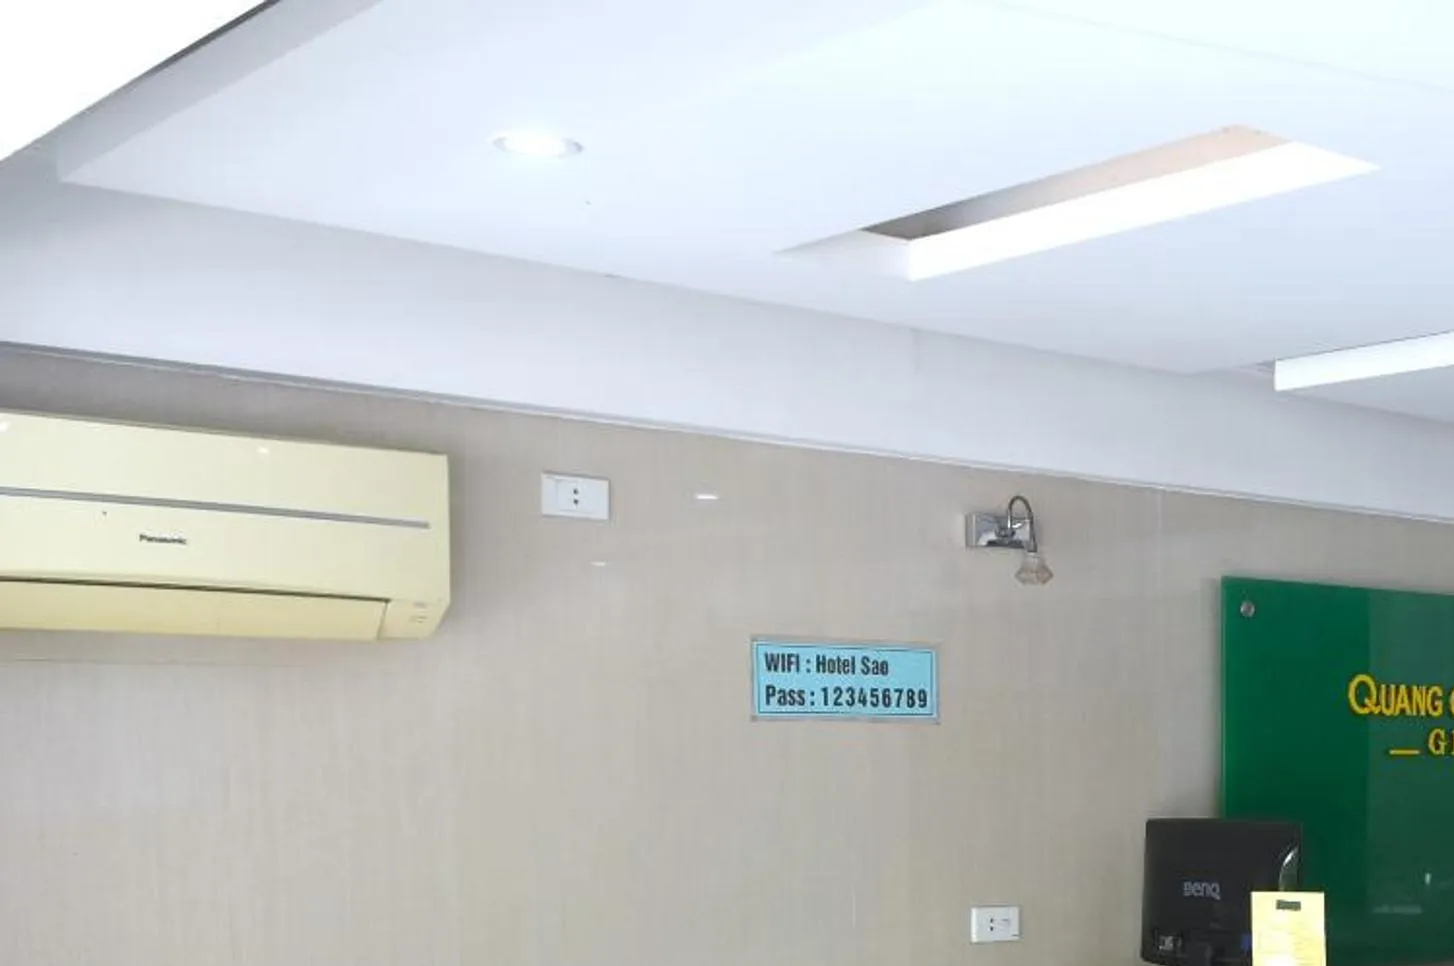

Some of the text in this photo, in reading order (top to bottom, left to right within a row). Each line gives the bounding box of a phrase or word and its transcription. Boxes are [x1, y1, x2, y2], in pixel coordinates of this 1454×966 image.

[764, 652, 800, 673] WIFI
[815, 654, 856, 675] Hotel
[860, 656, 889, 676] Sao
[765, 684, 806, 706] Pass
[821, 686, 928, 709] 123456789
[1348, 673, 1444, 717] QUANG
[1183, 881, 1221, 900] BenQ
